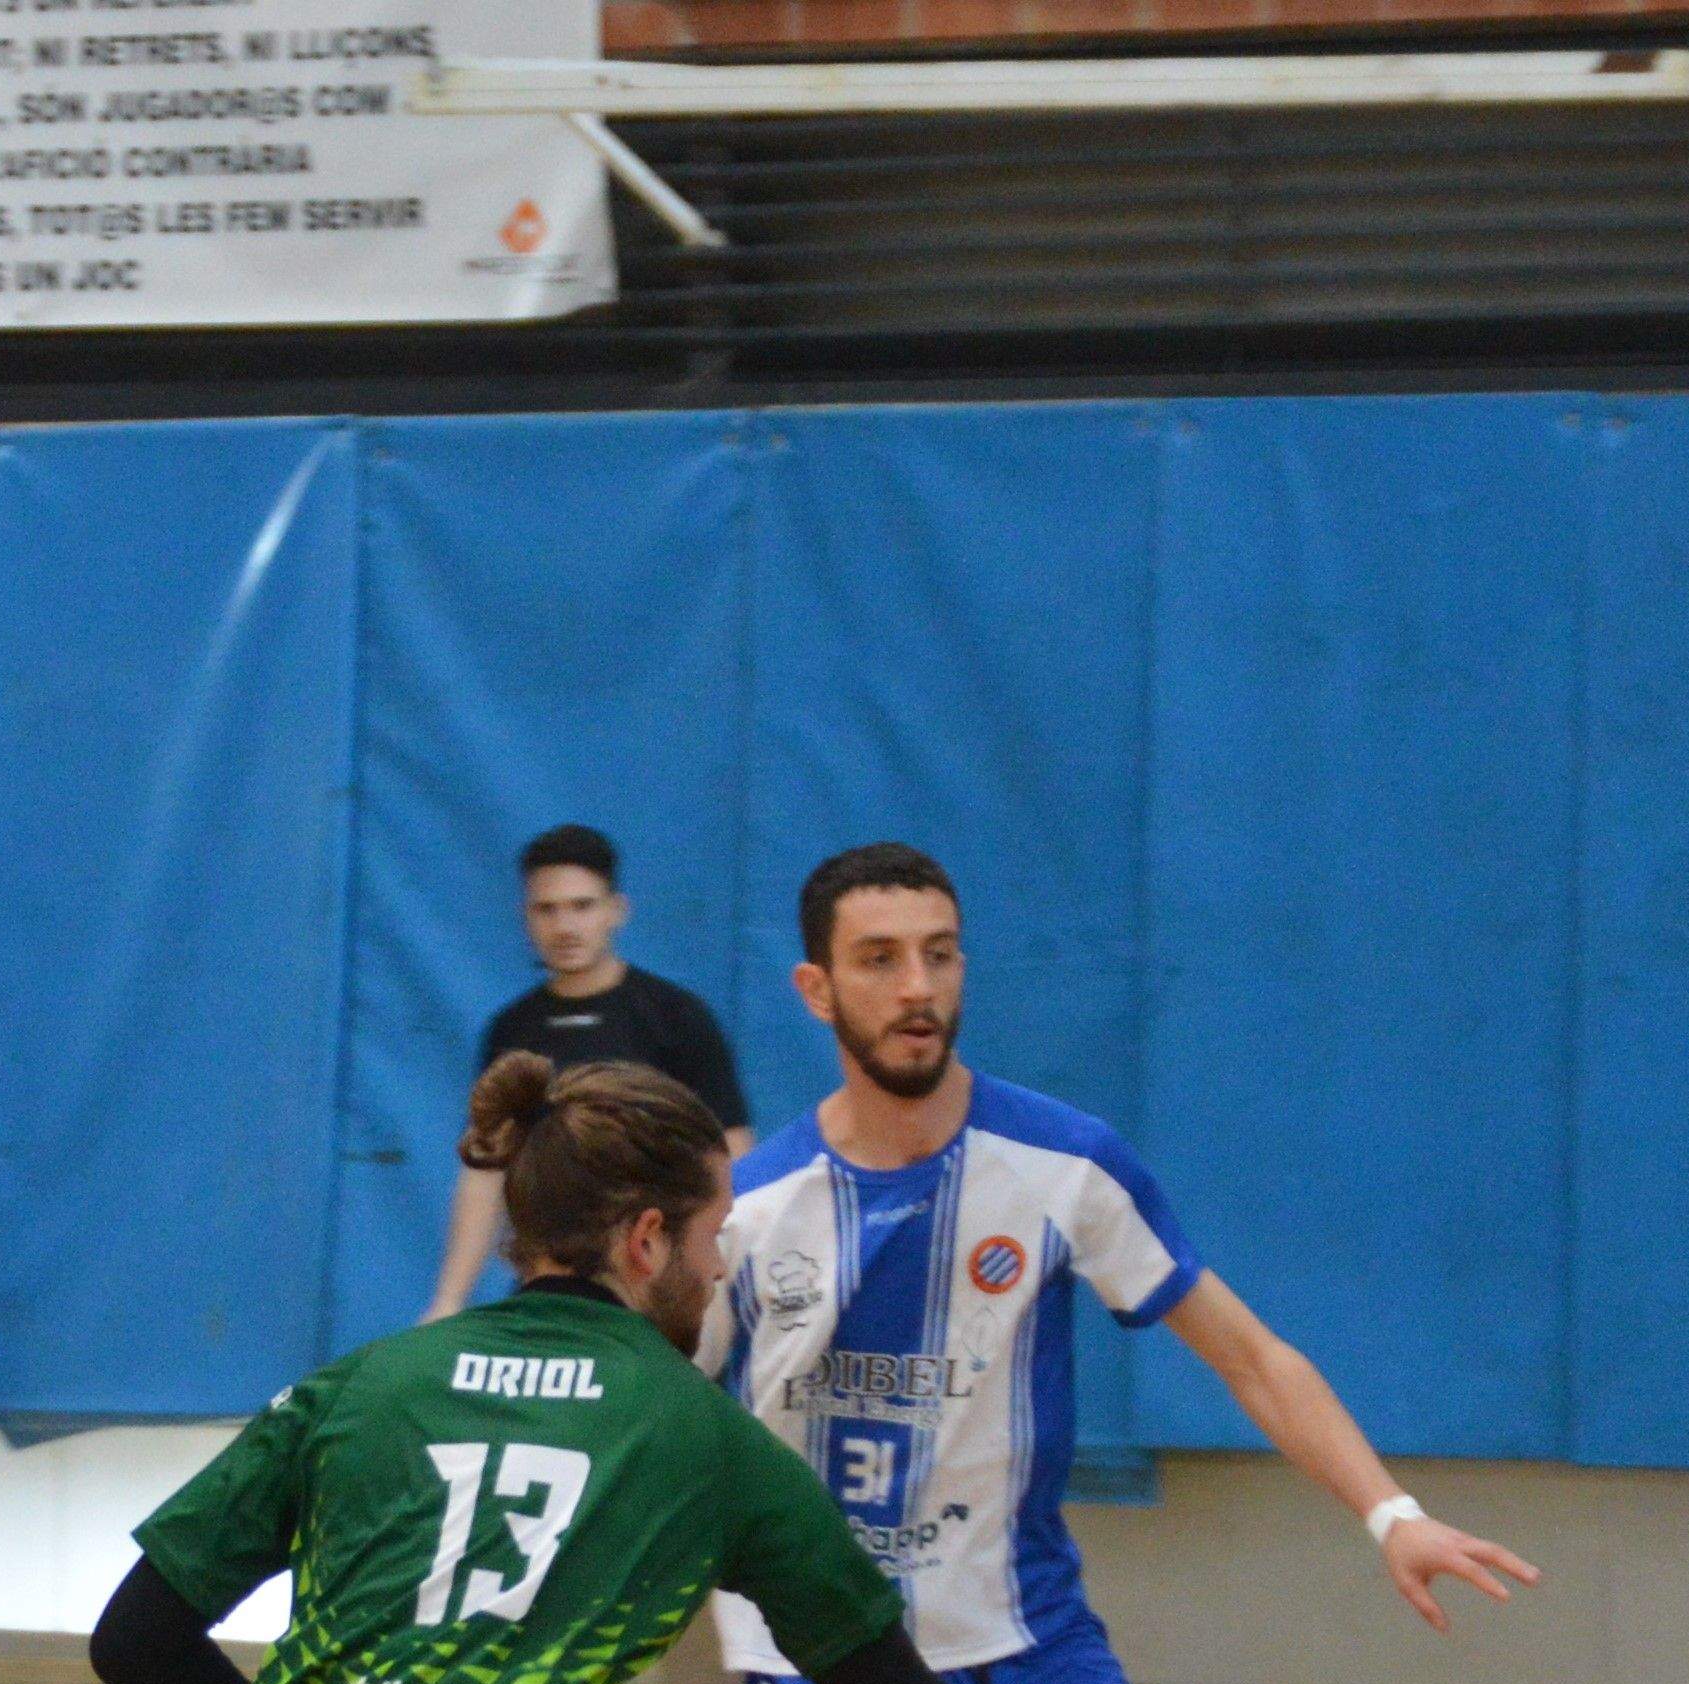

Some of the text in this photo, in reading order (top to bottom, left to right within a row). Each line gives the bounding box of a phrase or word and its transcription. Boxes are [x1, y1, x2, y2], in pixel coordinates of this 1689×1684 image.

[157, 201, 213, 234] LES
[451, 1352, 604, 1400] ORIOL
[841, 1438, 897, 1505] 31
[414, 1442, 591, 1627] 13
